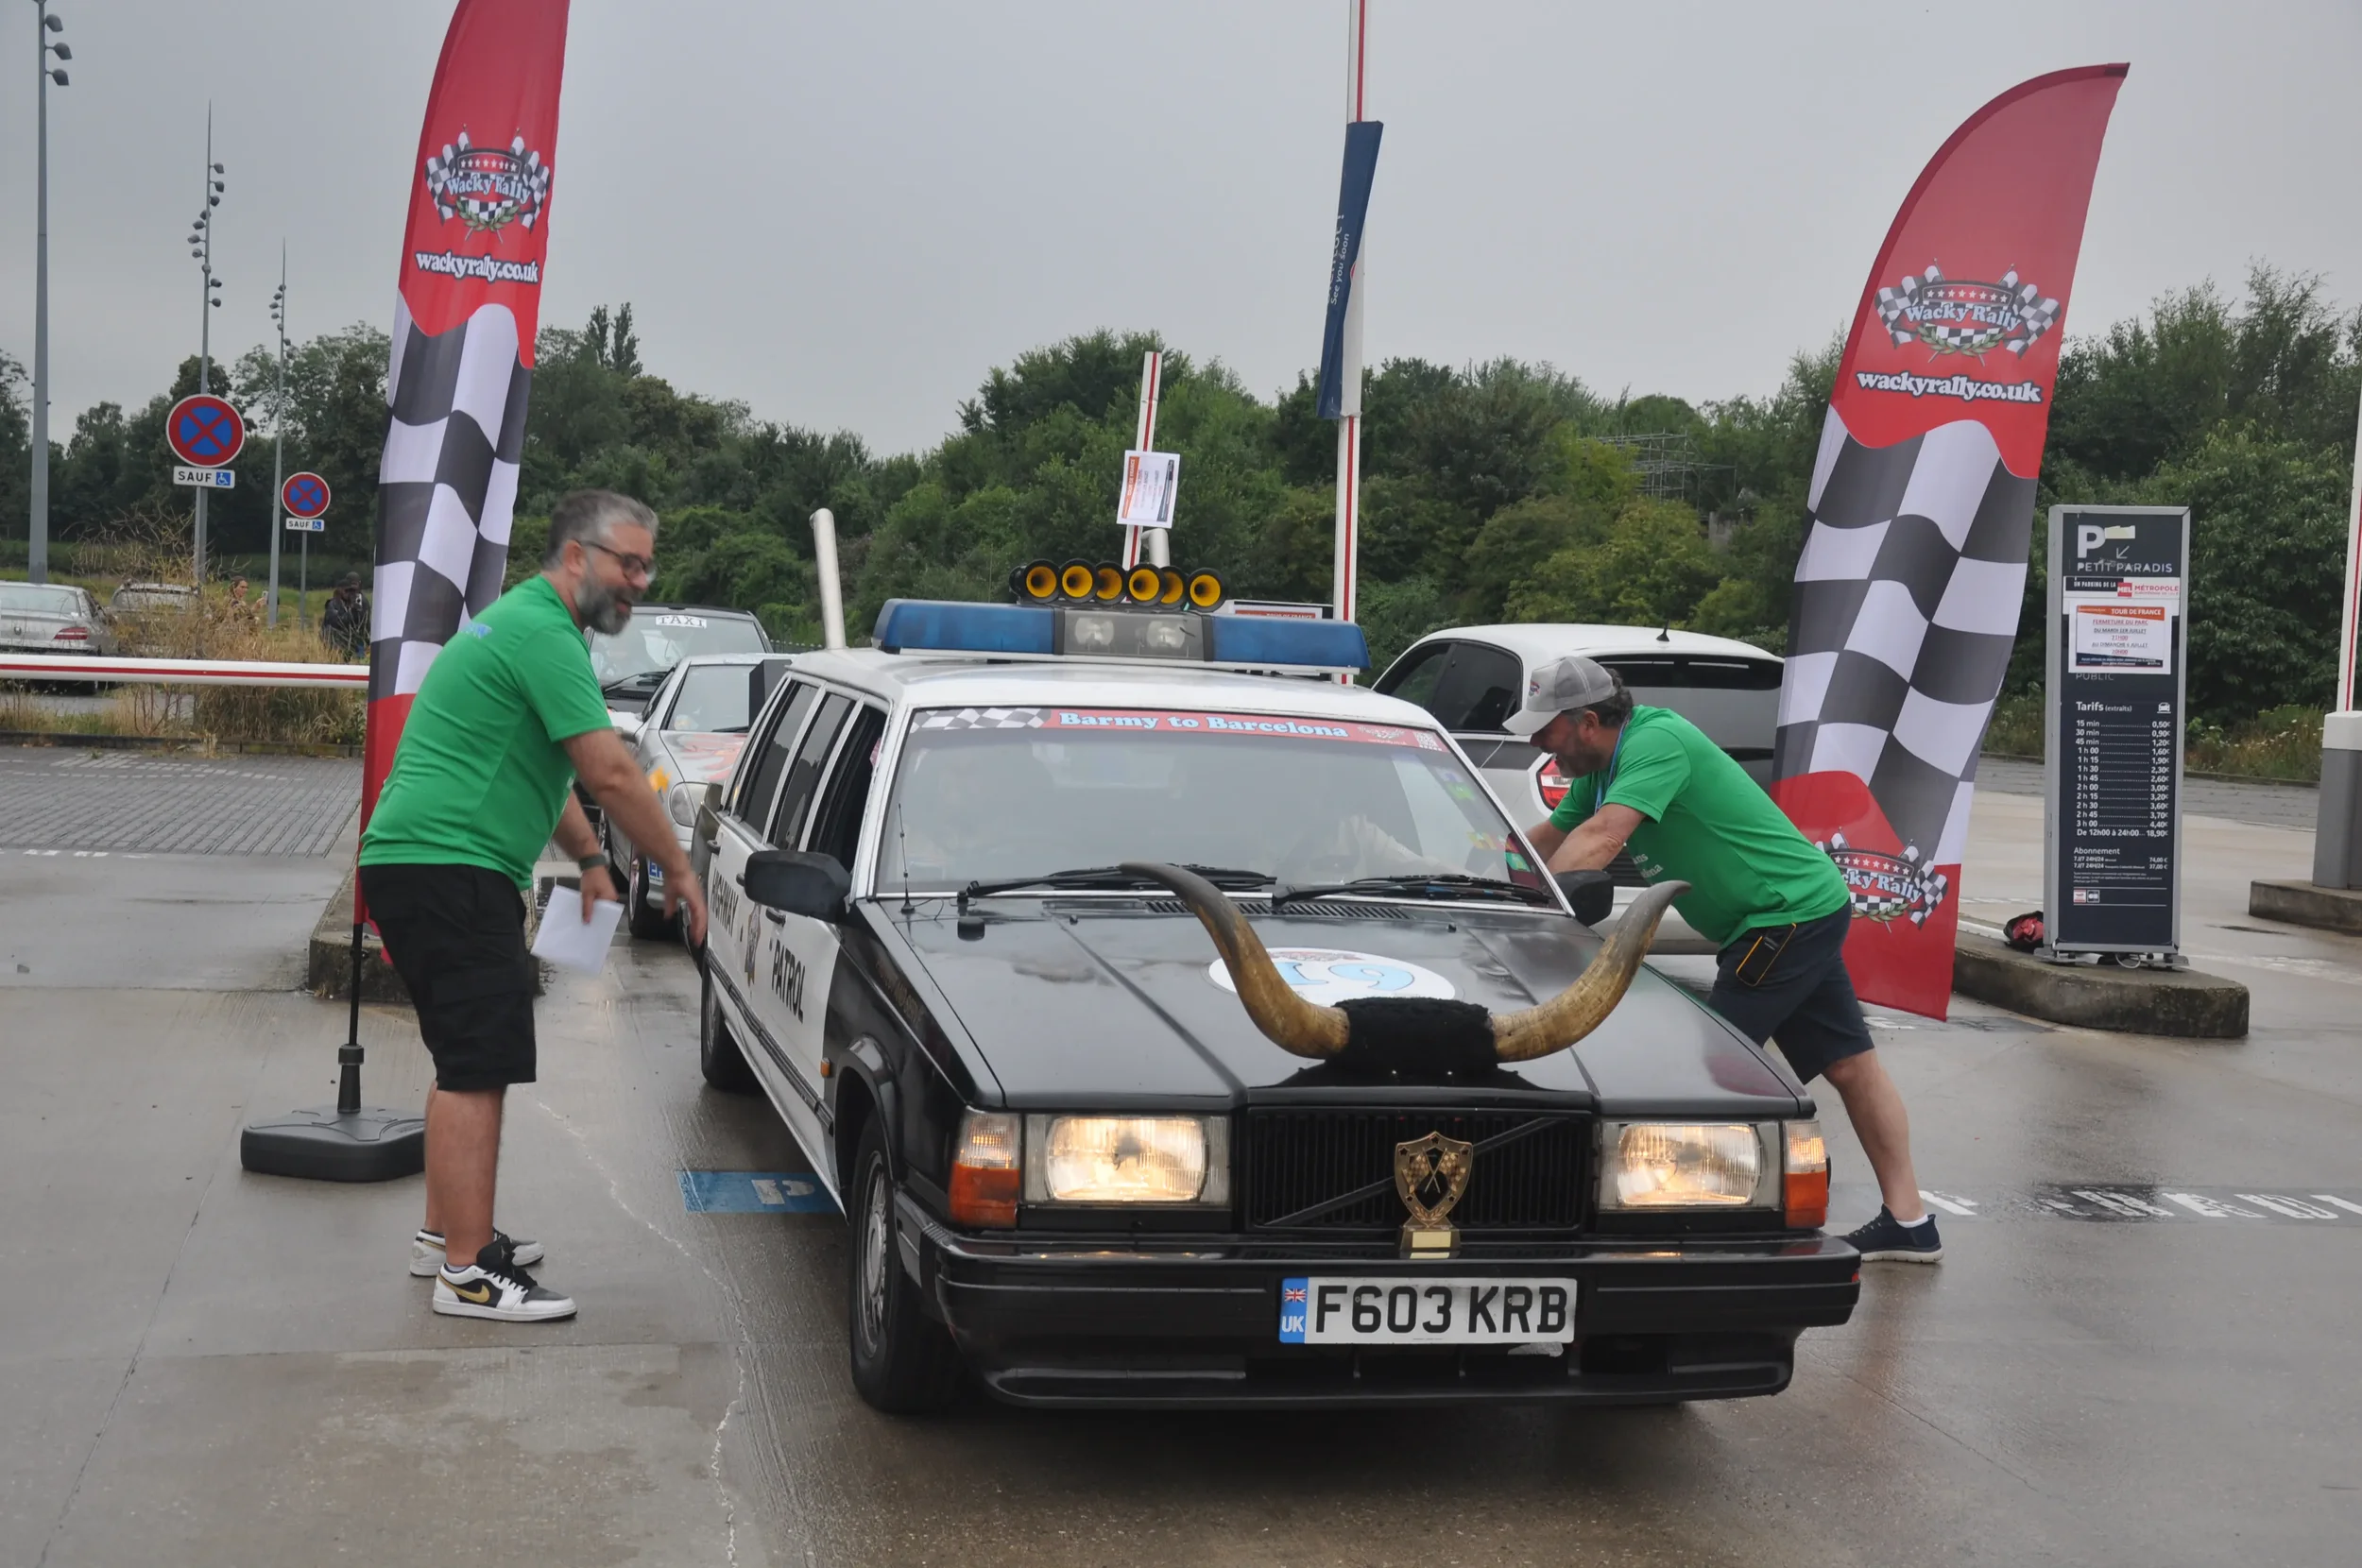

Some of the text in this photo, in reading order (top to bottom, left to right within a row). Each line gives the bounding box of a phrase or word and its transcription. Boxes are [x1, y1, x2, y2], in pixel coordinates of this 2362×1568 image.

[446, 174, 531, 204] Wacky Rally
[415, 249, 539, 282] wackyrally.co.uk
[1330, 285, 1340, 305] See
[1341, 233, 1349, 260] soon
[1905, 300, 2021, 331] Wacky Rally
[1856, 371, 2044, 402] wackyrally.co.uk
[178, 470, 213, 483] SAUF
[2077, 525, 2106, 558] P
[2077, 561, 2173, 572] PETIT PARADIS
[660, 615, 703, 626] TAXI
[2076, 701, 2104, 711] Tarifs
[1058, 712, 1159, 729] Barmy
[1168, 716, 1199, 728] to
[1207, 716, 1349, 737] Barcelona
[710, 867, 739, 937] HIGHWAY
[1841, 870, 1923, 903] cky Rally
[772, 939, 805, 1025] PATROL
[1281, 1315, 1305, 1333] UK
[1316, 1285, 1568, 1334] F603 KRB
